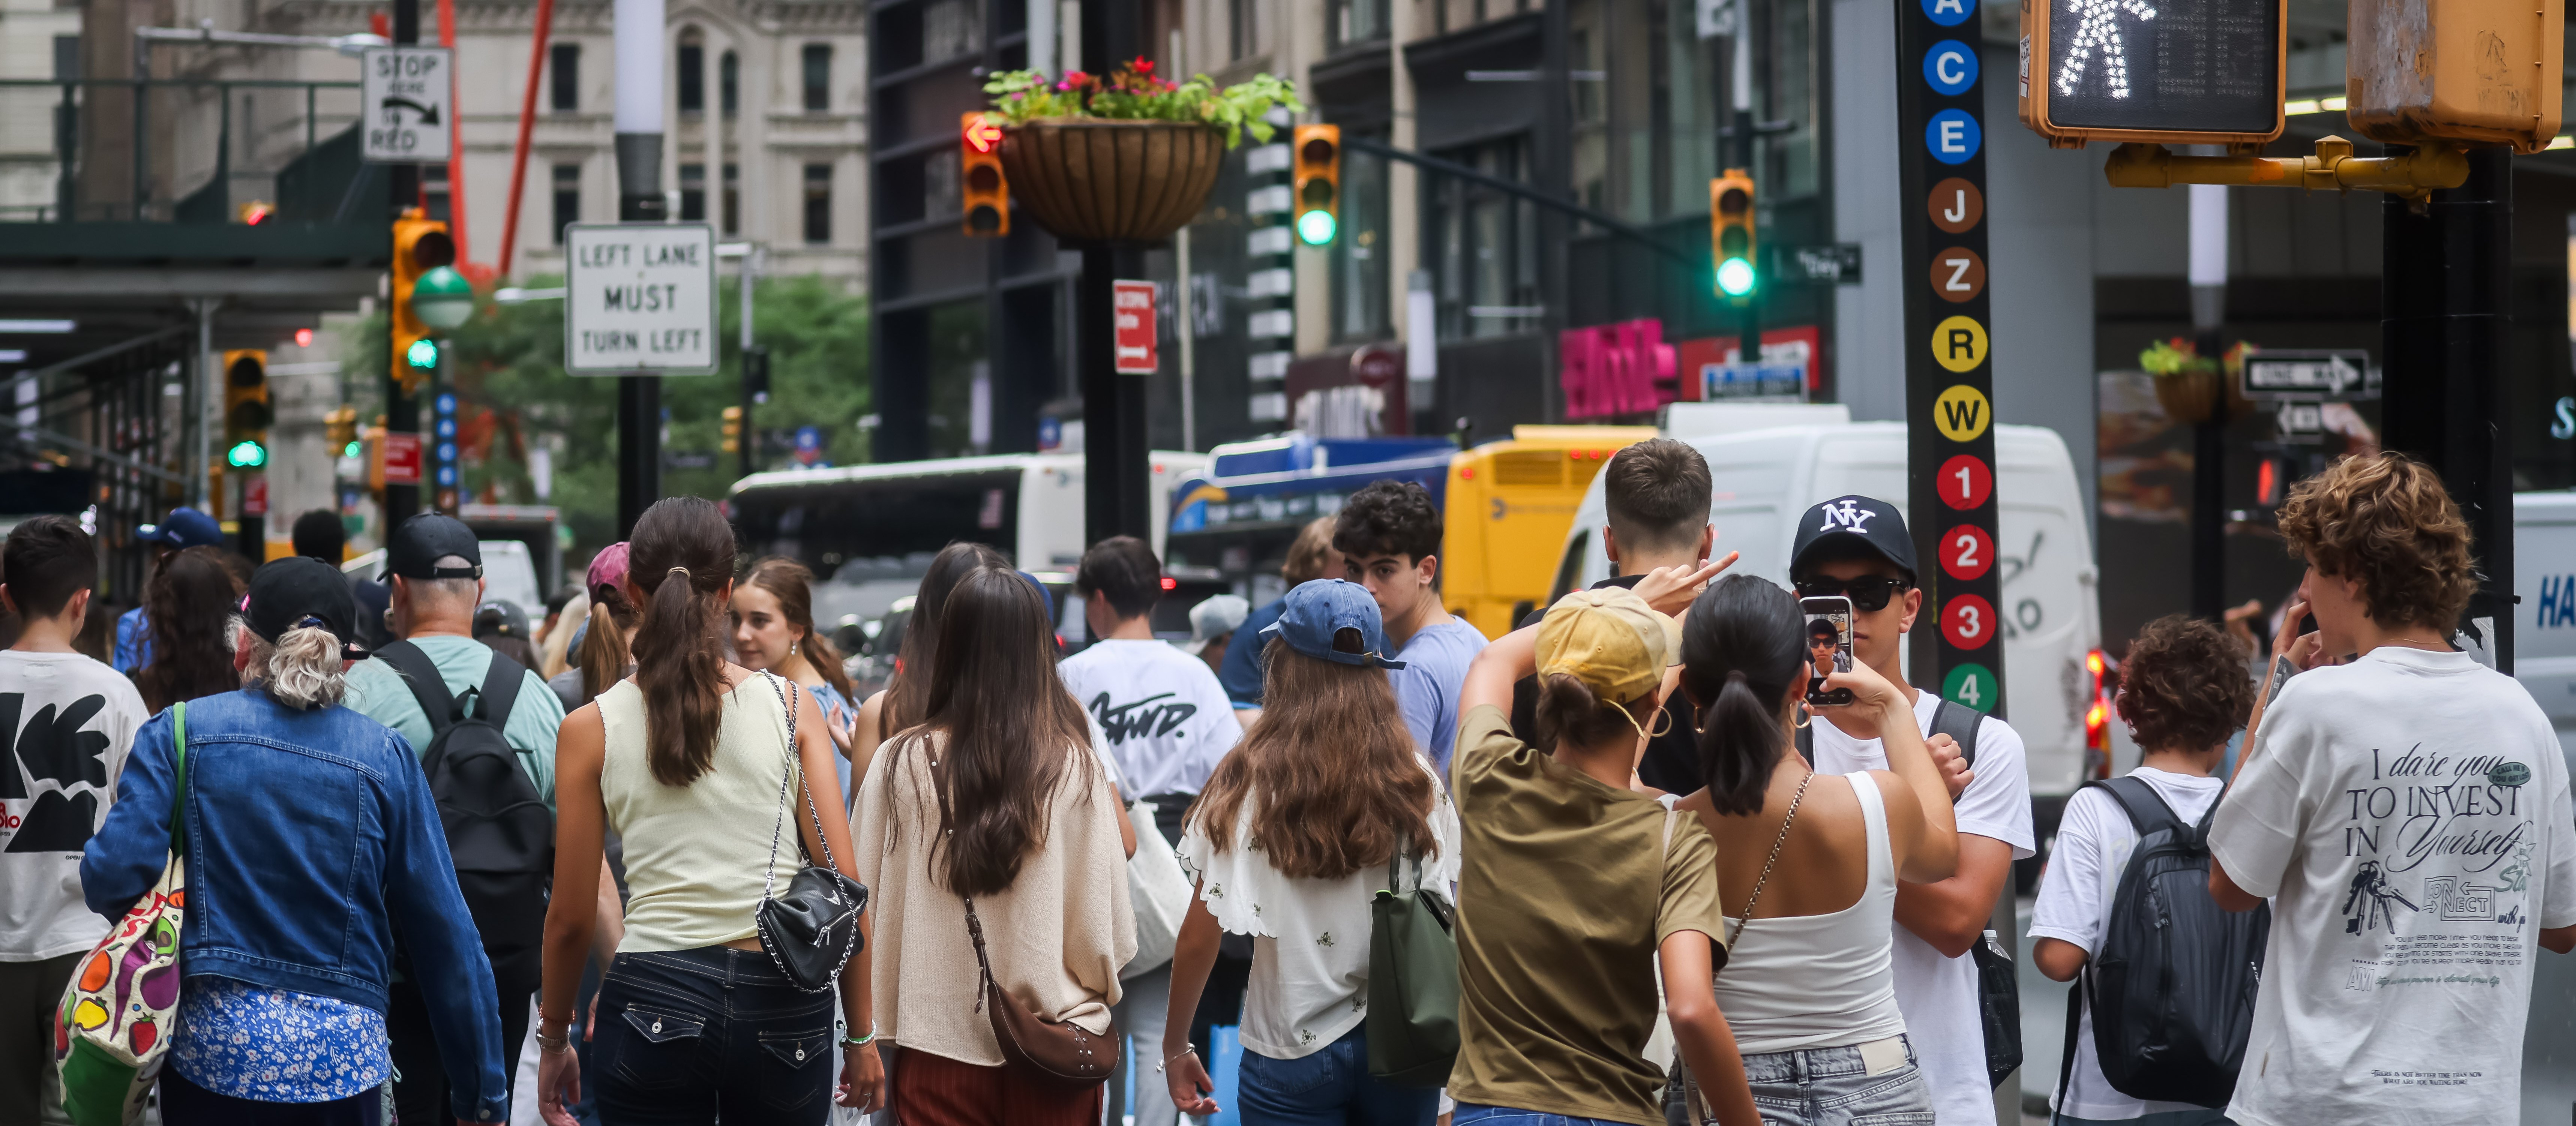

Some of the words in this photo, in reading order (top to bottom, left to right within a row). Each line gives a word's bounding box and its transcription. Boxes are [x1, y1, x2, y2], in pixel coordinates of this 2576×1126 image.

[377, 55, 439, 77] STOP
[1937, 51, 1965, 84] C
[371, 130, 417, 151] RED
[1940, 120, 1965, 153] E
[1944, 190, 1965, 223] J
[580, 244, 631, 268] LEFT
[644, 244, 699, 267] LANE
[1946, 258, 1971, 291] Z
[604, 284, 676, 312] MUST
[582, 329, 638, 352] TURN
[650, 329, 702, 352] LEFT
[1948, 328, 1974, 360] R
[1943, 400, 1980, 431] W
[1955, 467, 1971, 498] 1
[1820, 500, 1876, 534] NY
[1956, 535, 1978, 567] 2
[1958, 605, 1980, 638] 3
[1958, 674, 1980, 706] 4
[2372, 748, 2380, 780] I
[2389, 742, 2449, 777] dare
[2438, 755, 2505, 790] you
[2346, 786, 2396, 820] TO
[2407, 785, 2522, 817] INVEST
[2345, 825, 2381, 857] IN
